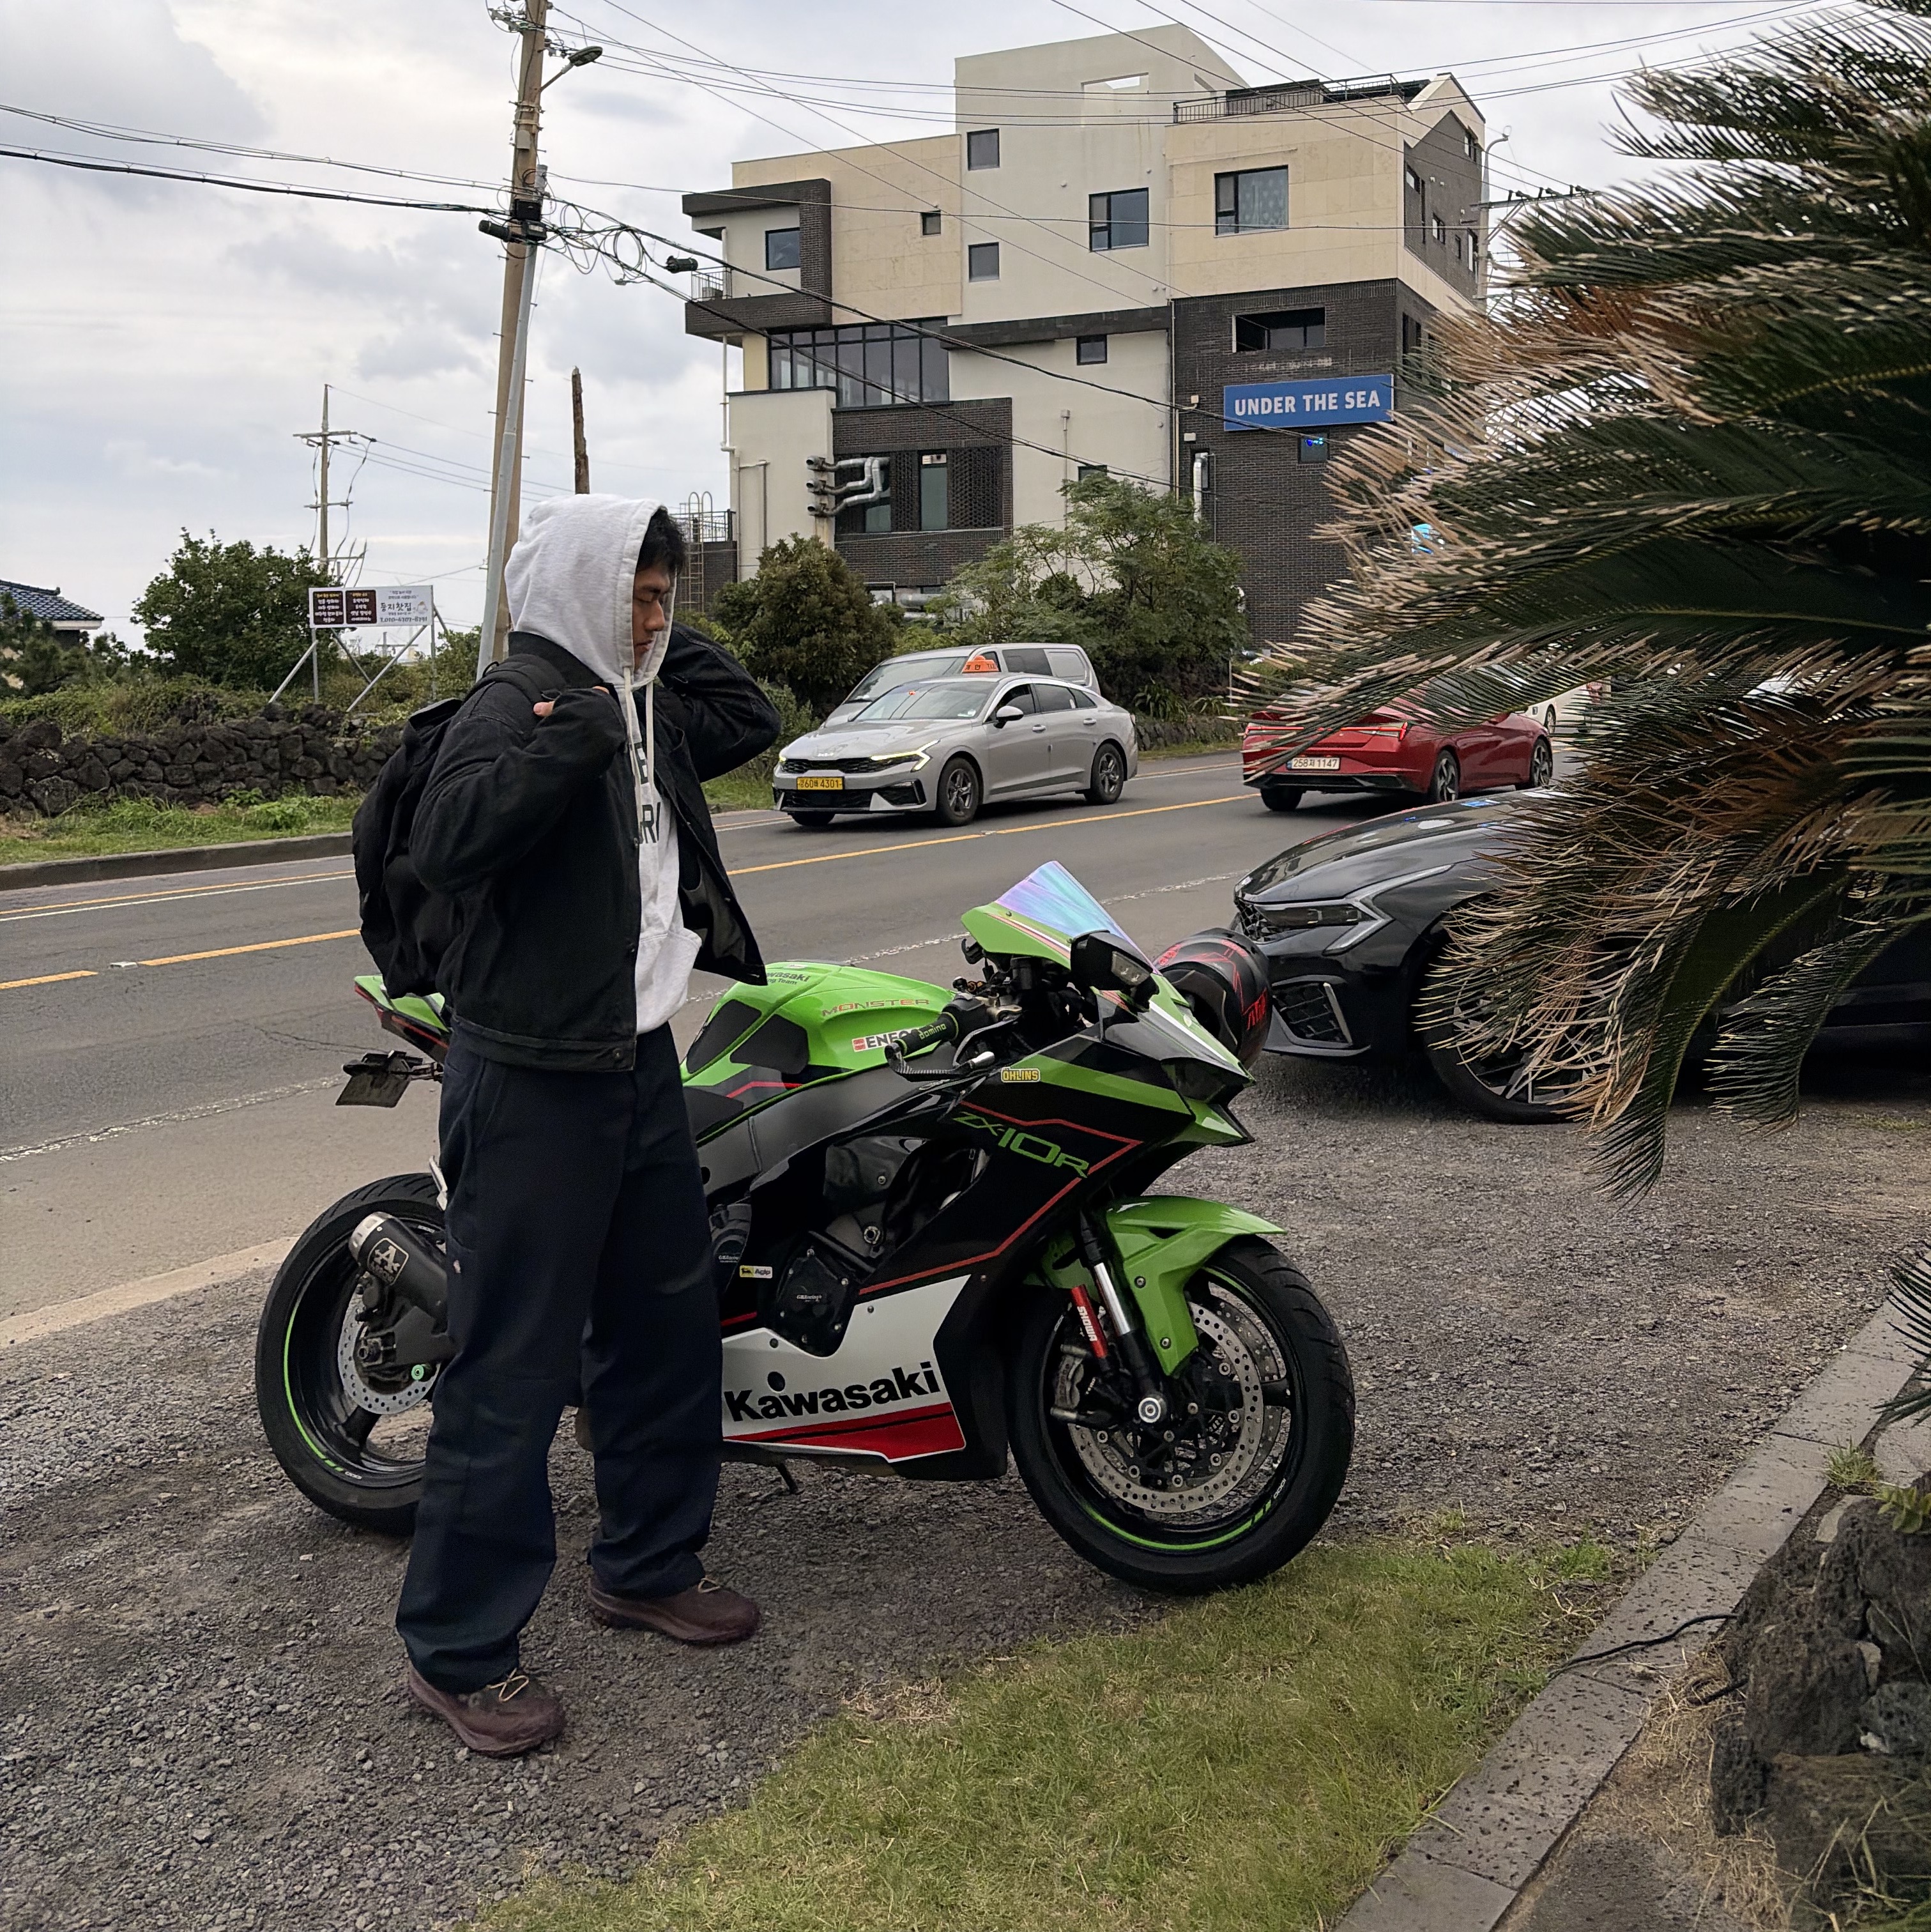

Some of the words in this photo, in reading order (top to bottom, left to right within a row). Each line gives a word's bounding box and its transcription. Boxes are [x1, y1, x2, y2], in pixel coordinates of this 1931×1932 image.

[1235, 396, 1296, 416] UNDER
[1302, 393, 1338, 412] THE
[1345, 390, 1380, 409] SEA
[821, 999, 930, 1017] MONSTER
[918, 1023, 947, 1040] domino
[1076, 1306, 1096, 1342] SHOWA
[724, 1361, 941, 1422] Kawasaki
